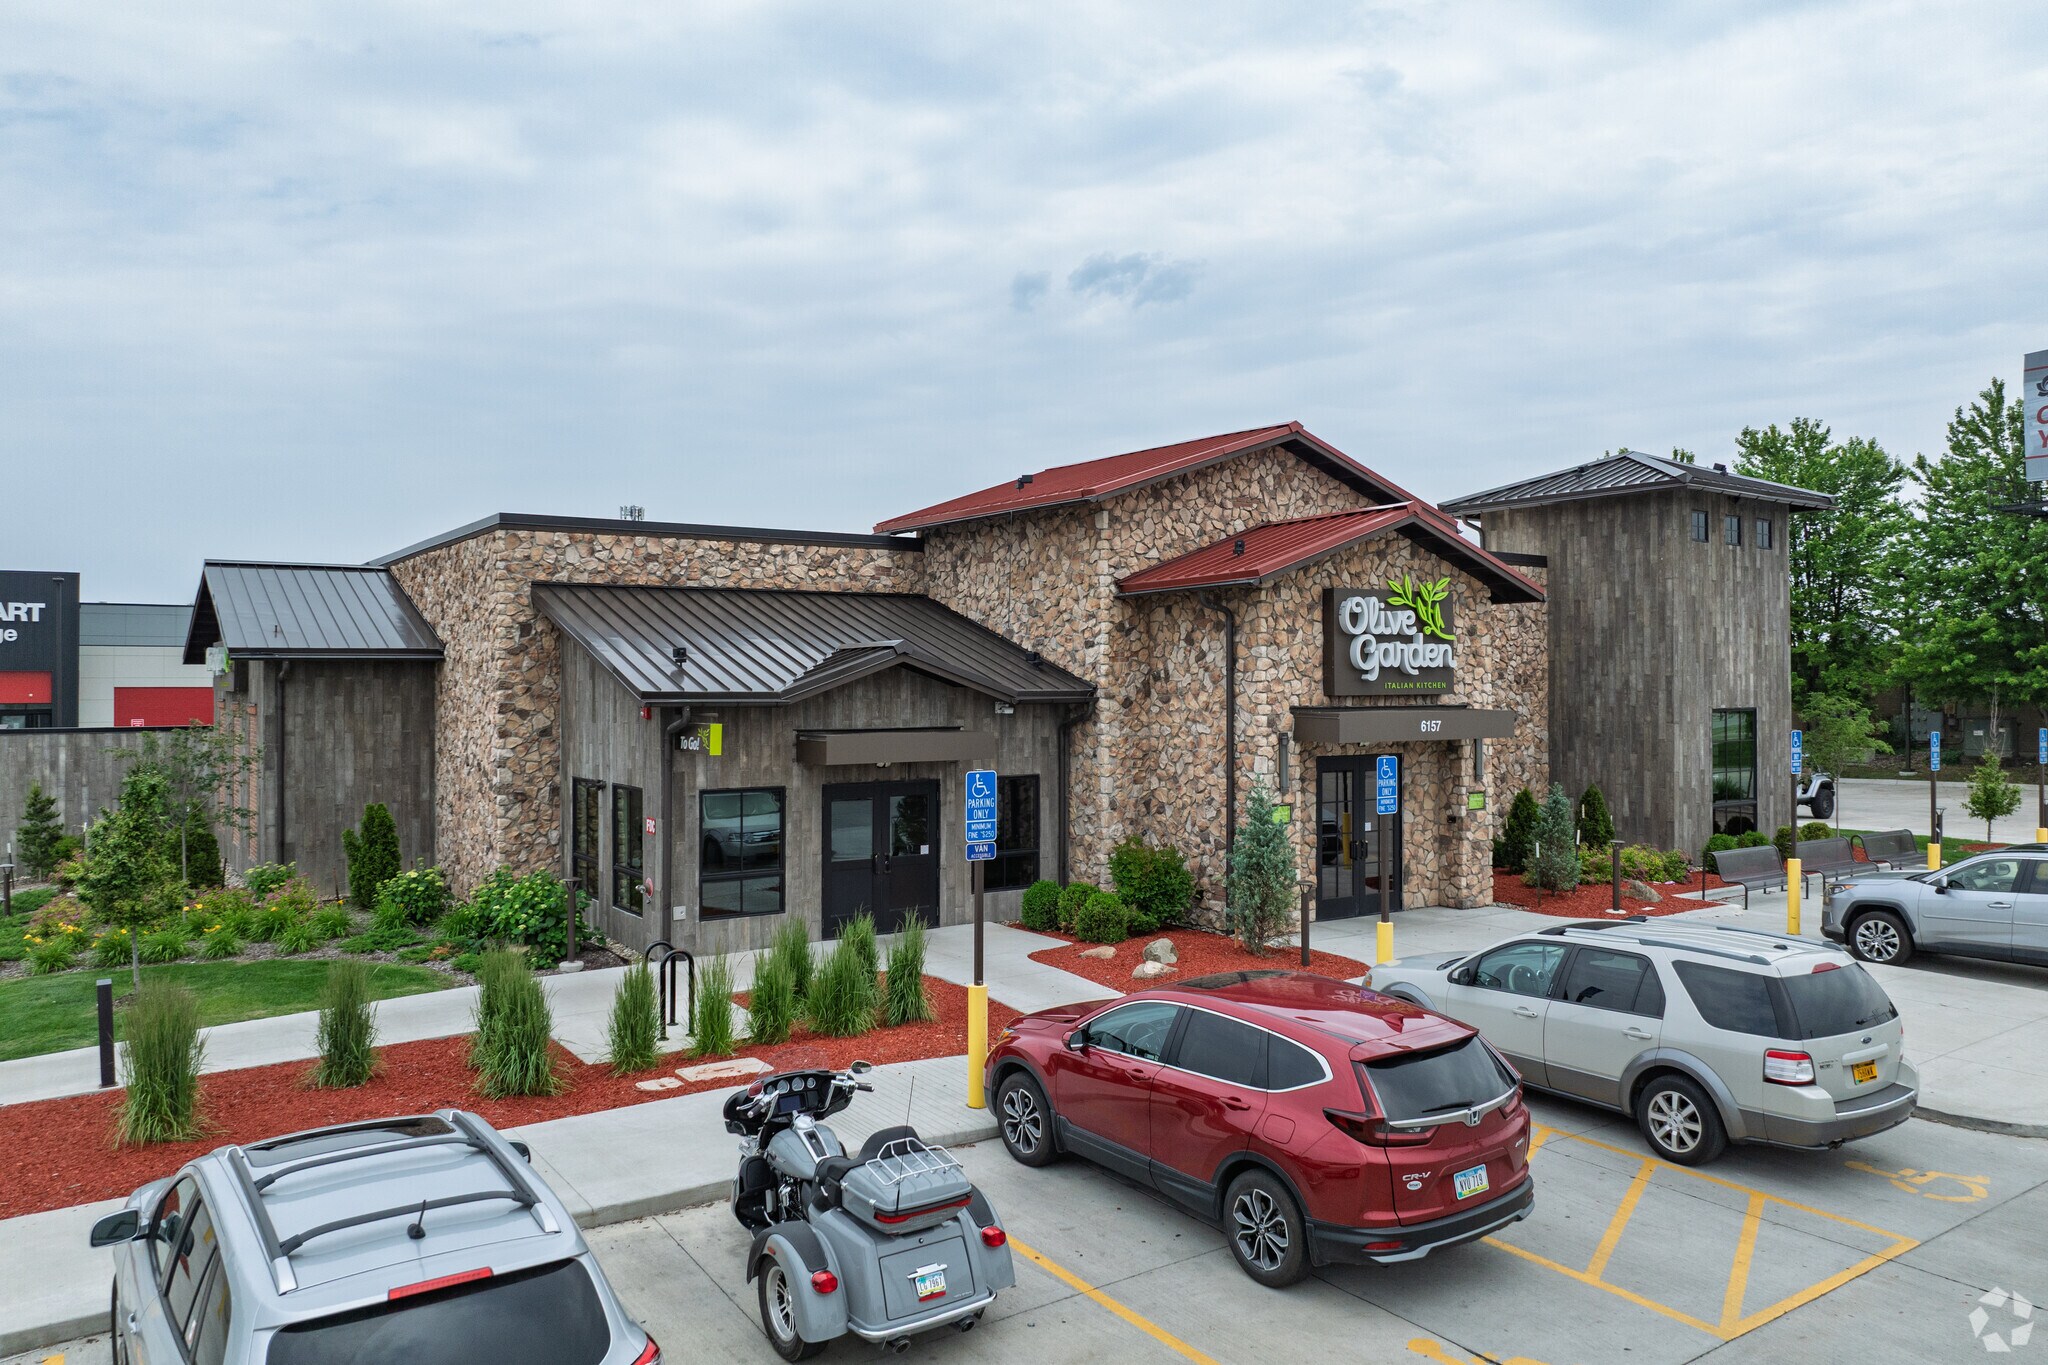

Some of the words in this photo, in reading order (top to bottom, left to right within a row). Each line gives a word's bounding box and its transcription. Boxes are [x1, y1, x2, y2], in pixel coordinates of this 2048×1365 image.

[1339, 596, 1418, 636] Olive
[1350, 633, 1457, 681] Garden
[1421, 720, 1442, 732] 6157
[680, 736, 688, 749] To
[688, 736, 700, 751] Go!
[1378, 778, 1396, 787] PARKING
[1382, 788, 1393, 796] ONLY
[968, 798, 995, 809] PARKING
[973, 809, 990, 819] ONLY
[974, 845, 989, 853] VAN
[1402, 1171, 1432, 1181] CR-V
